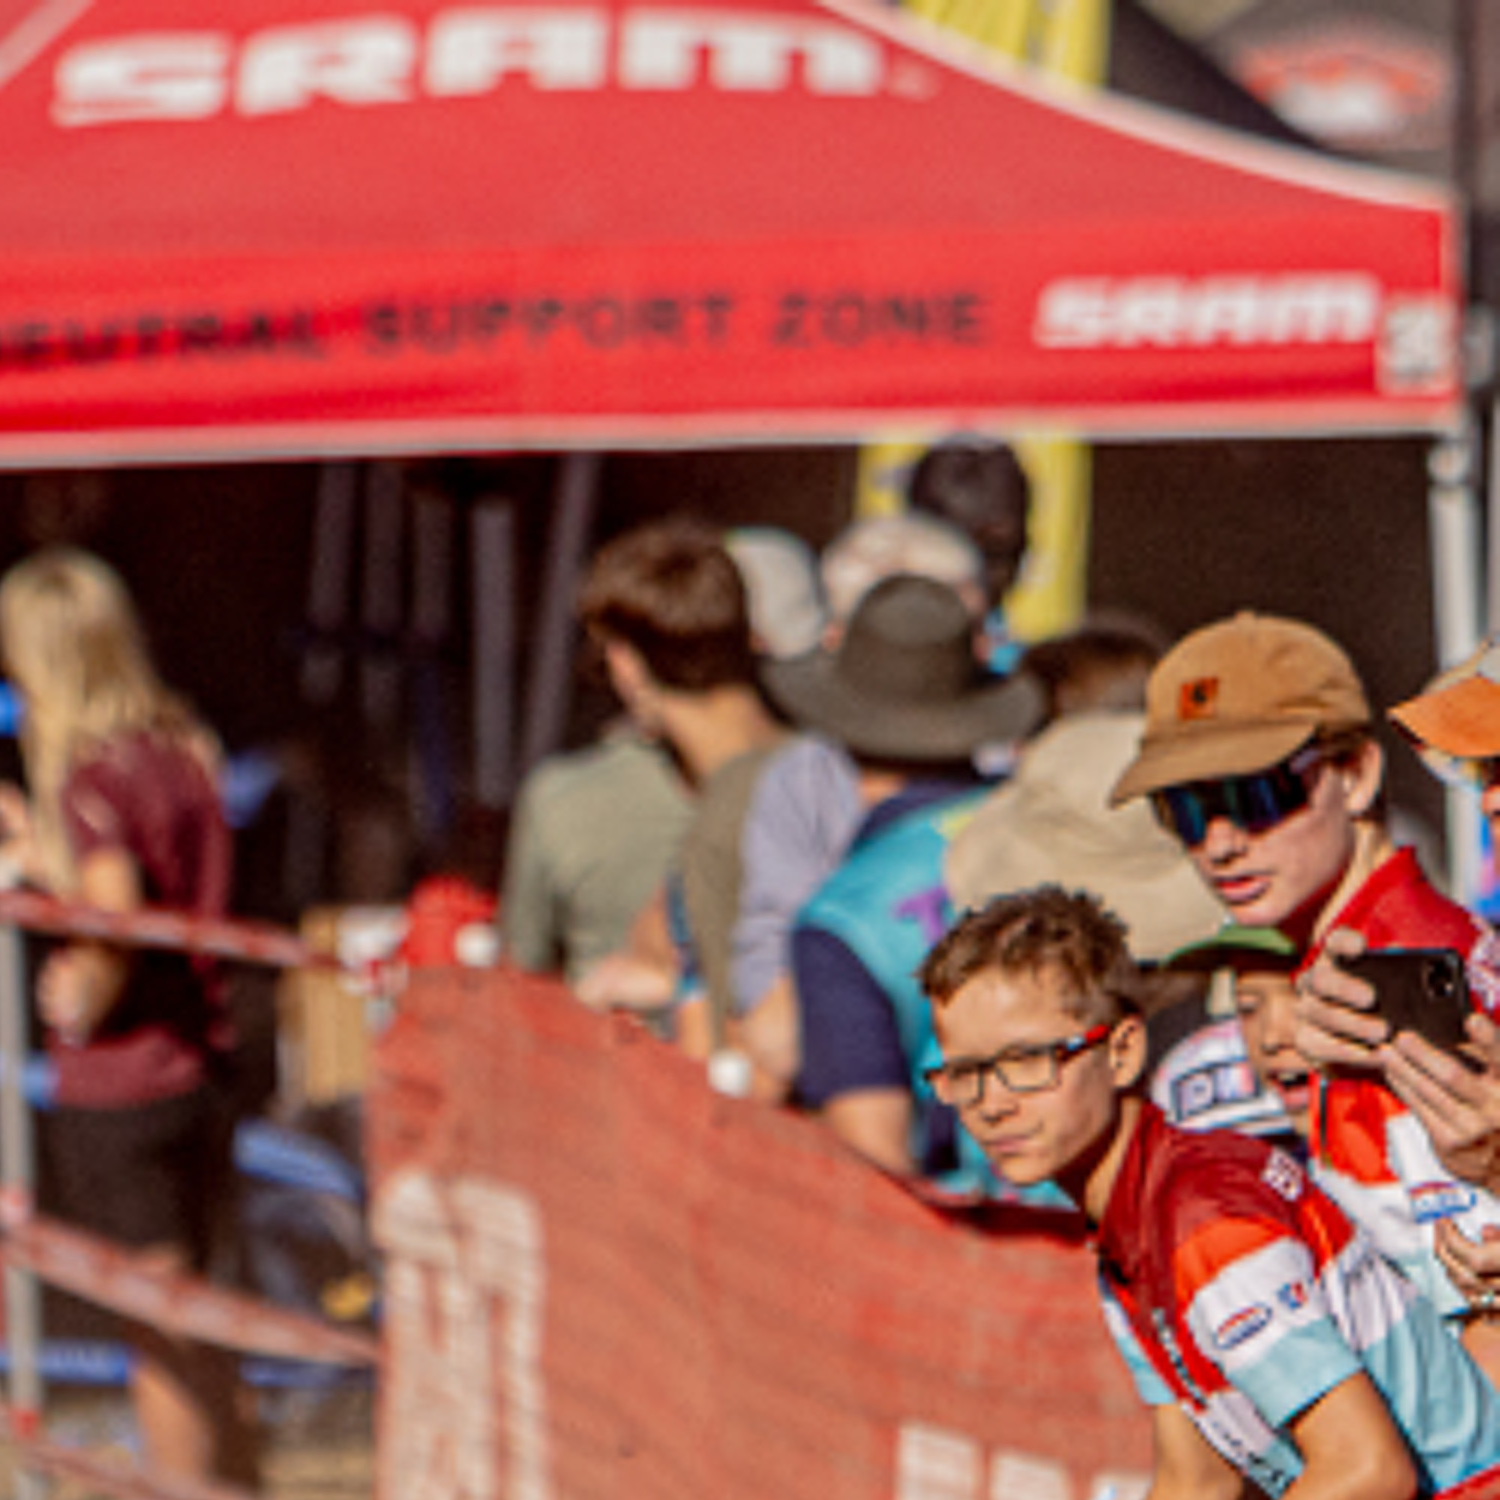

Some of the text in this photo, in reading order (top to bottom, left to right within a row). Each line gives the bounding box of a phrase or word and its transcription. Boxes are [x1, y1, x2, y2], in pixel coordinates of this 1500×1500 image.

[53, 8, 884, 127] SRAM
[362, 292, 734, 356] SUPPORT
[774, 290, 985, 347] ZONE
[1035, 272, 1376, 346] SRAM
